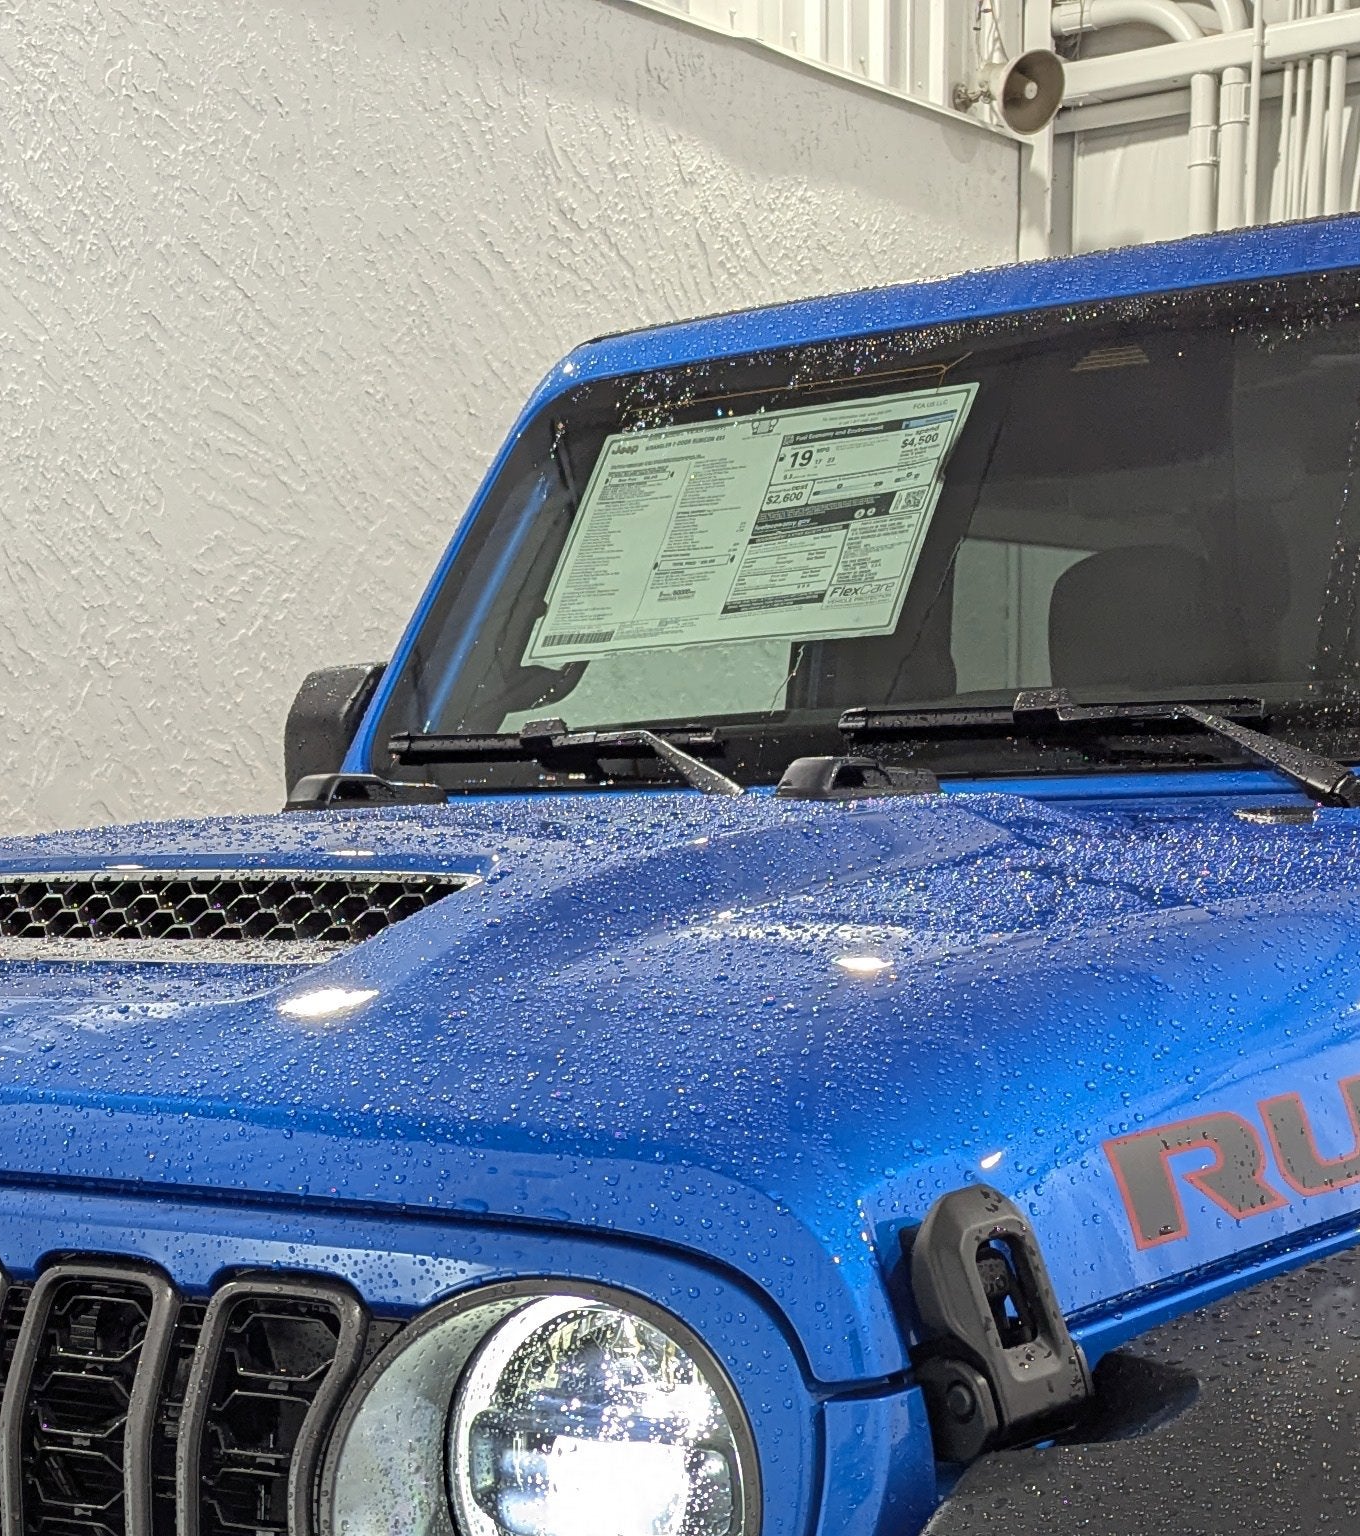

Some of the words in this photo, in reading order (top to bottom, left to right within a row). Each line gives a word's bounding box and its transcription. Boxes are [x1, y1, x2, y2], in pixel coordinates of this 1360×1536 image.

[901, 432, 939, 449] $4,500
[790, 449, 814, 468] 19
[765, 491, 804, 505] $2,600
[829, 581, 896, 598] FlexCare
